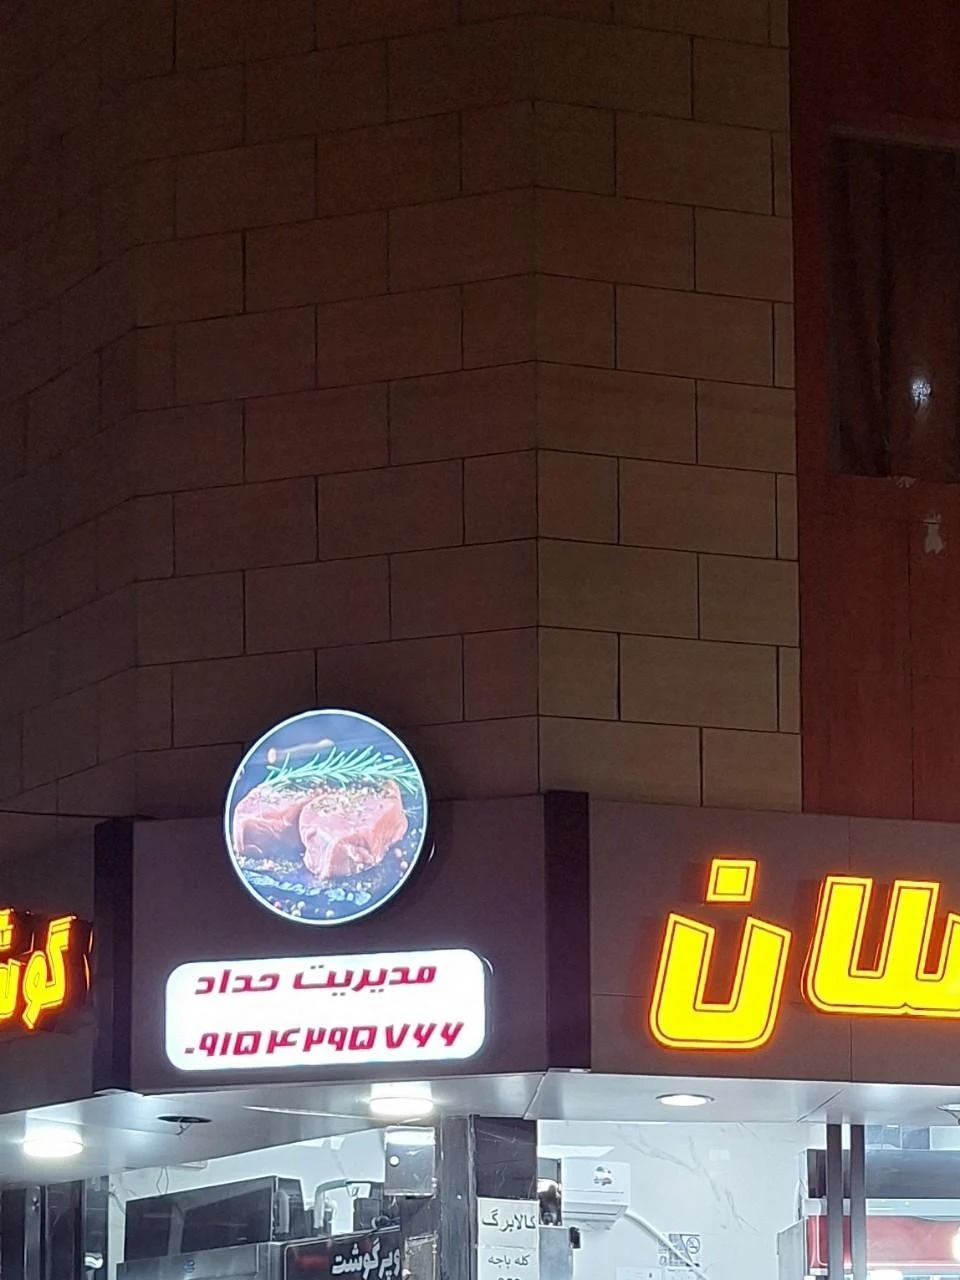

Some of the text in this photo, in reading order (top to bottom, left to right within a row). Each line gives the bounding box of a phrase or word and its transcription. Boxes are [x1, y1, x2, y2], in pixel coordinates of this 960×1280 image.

[195, 964, 437, 997] مدیریت حداد
[185, 1021, 464, 1057] ۰۹۱۵۴۲۹۵۷۶۶
[514, 1254, 530, 1266] کله
